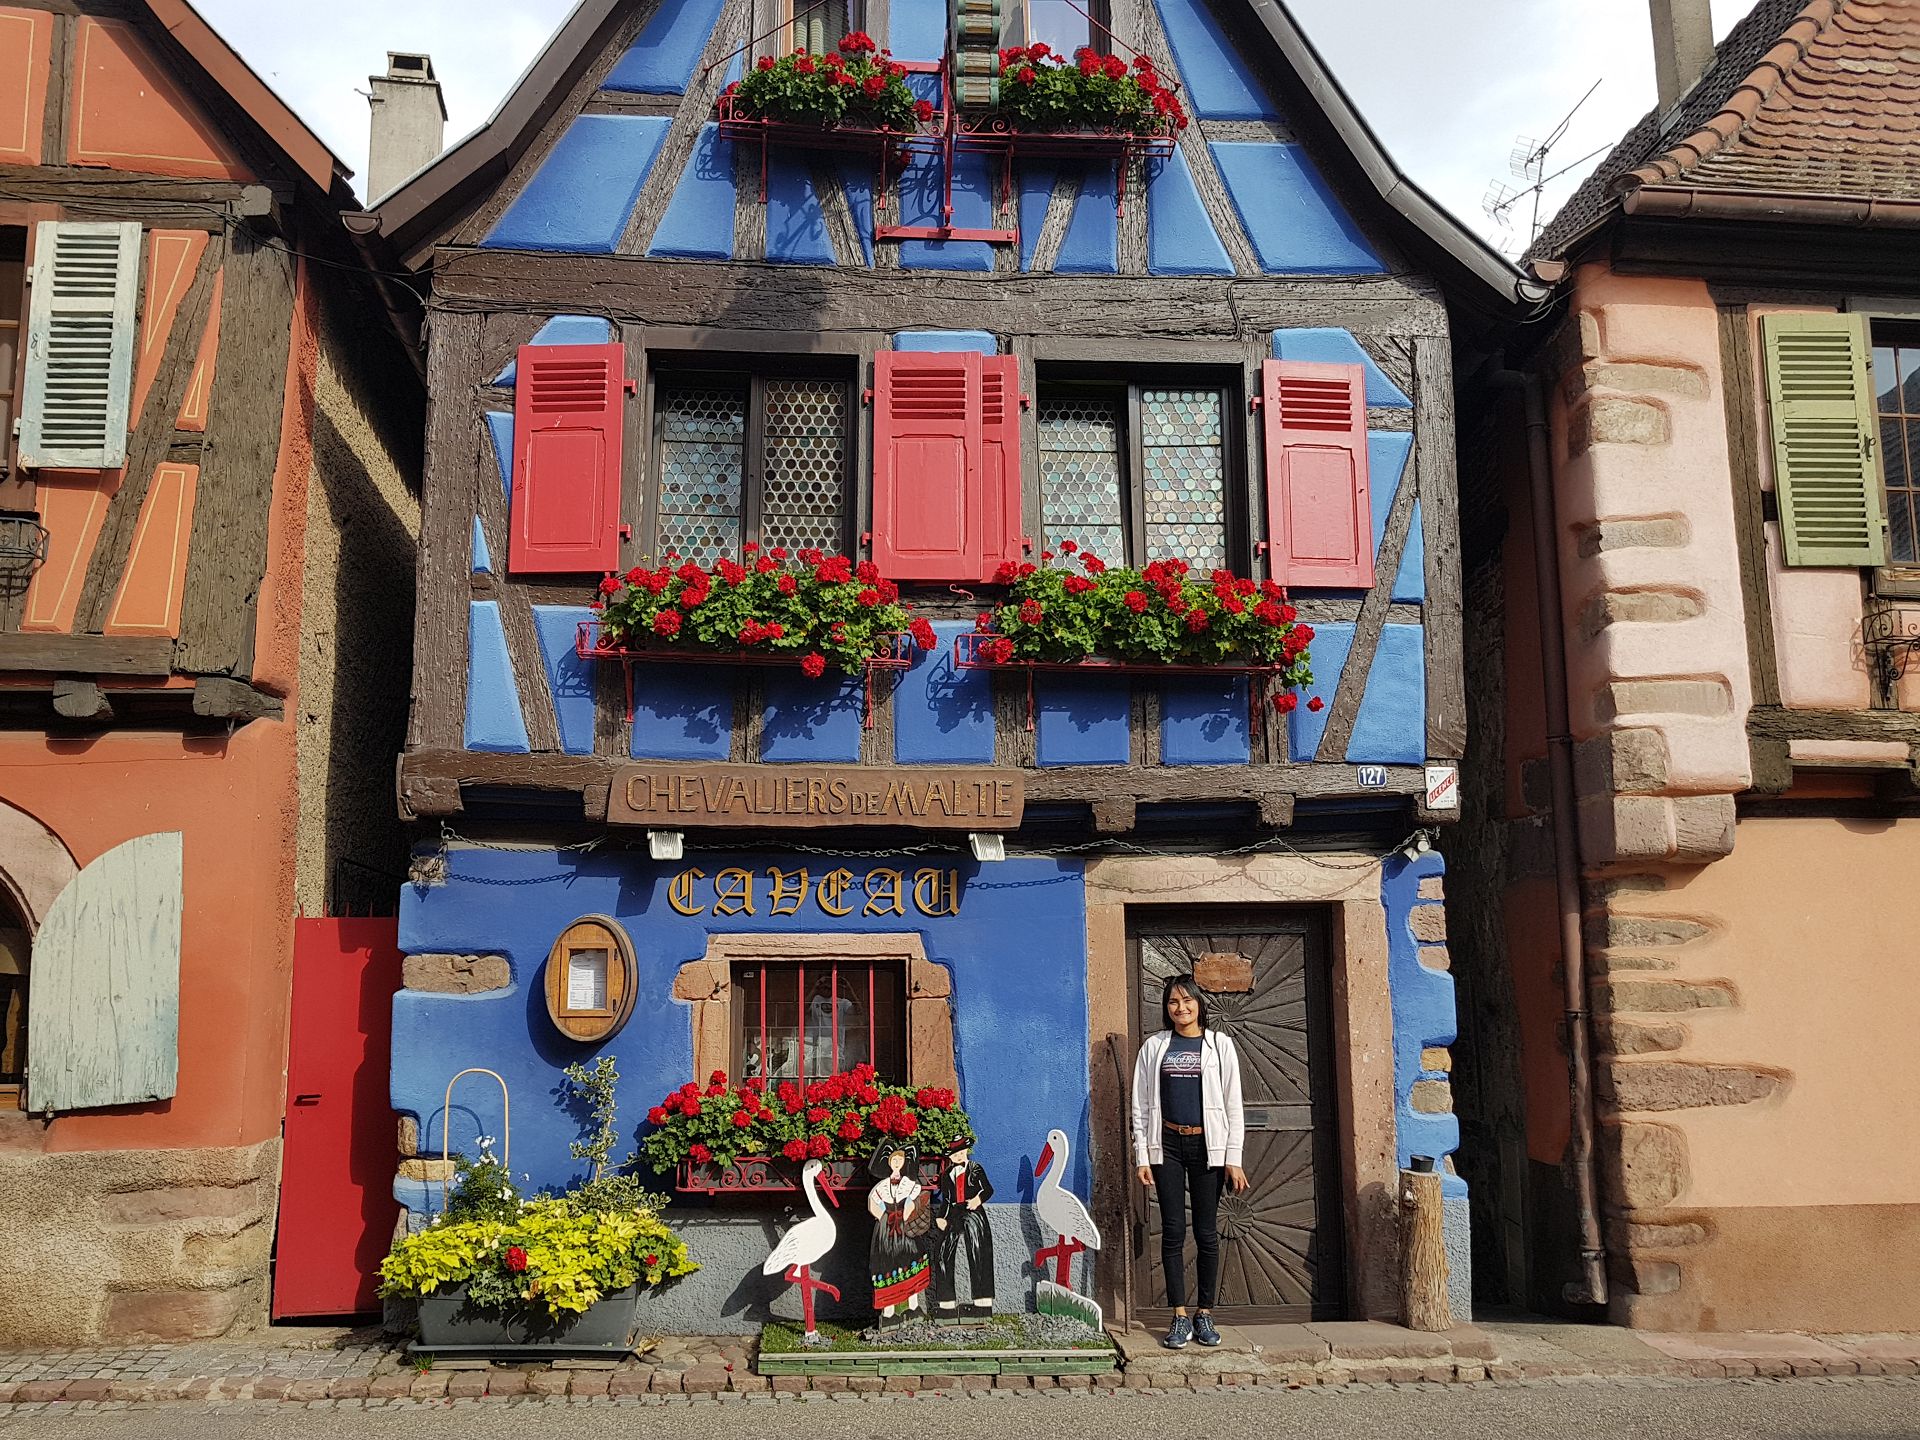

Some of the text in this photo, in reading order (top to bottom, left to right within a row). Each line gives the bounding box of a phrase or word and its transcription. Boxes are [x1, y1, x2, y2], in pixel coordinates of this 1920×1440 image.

[1361, 767, 1383, 785] 127
[1429, 773, 1454, 802] LICENCE
[626, 774, 1014, 817] CHEVALIERS DE MALTE
[667, 866, 961, 916] CAVEAU
